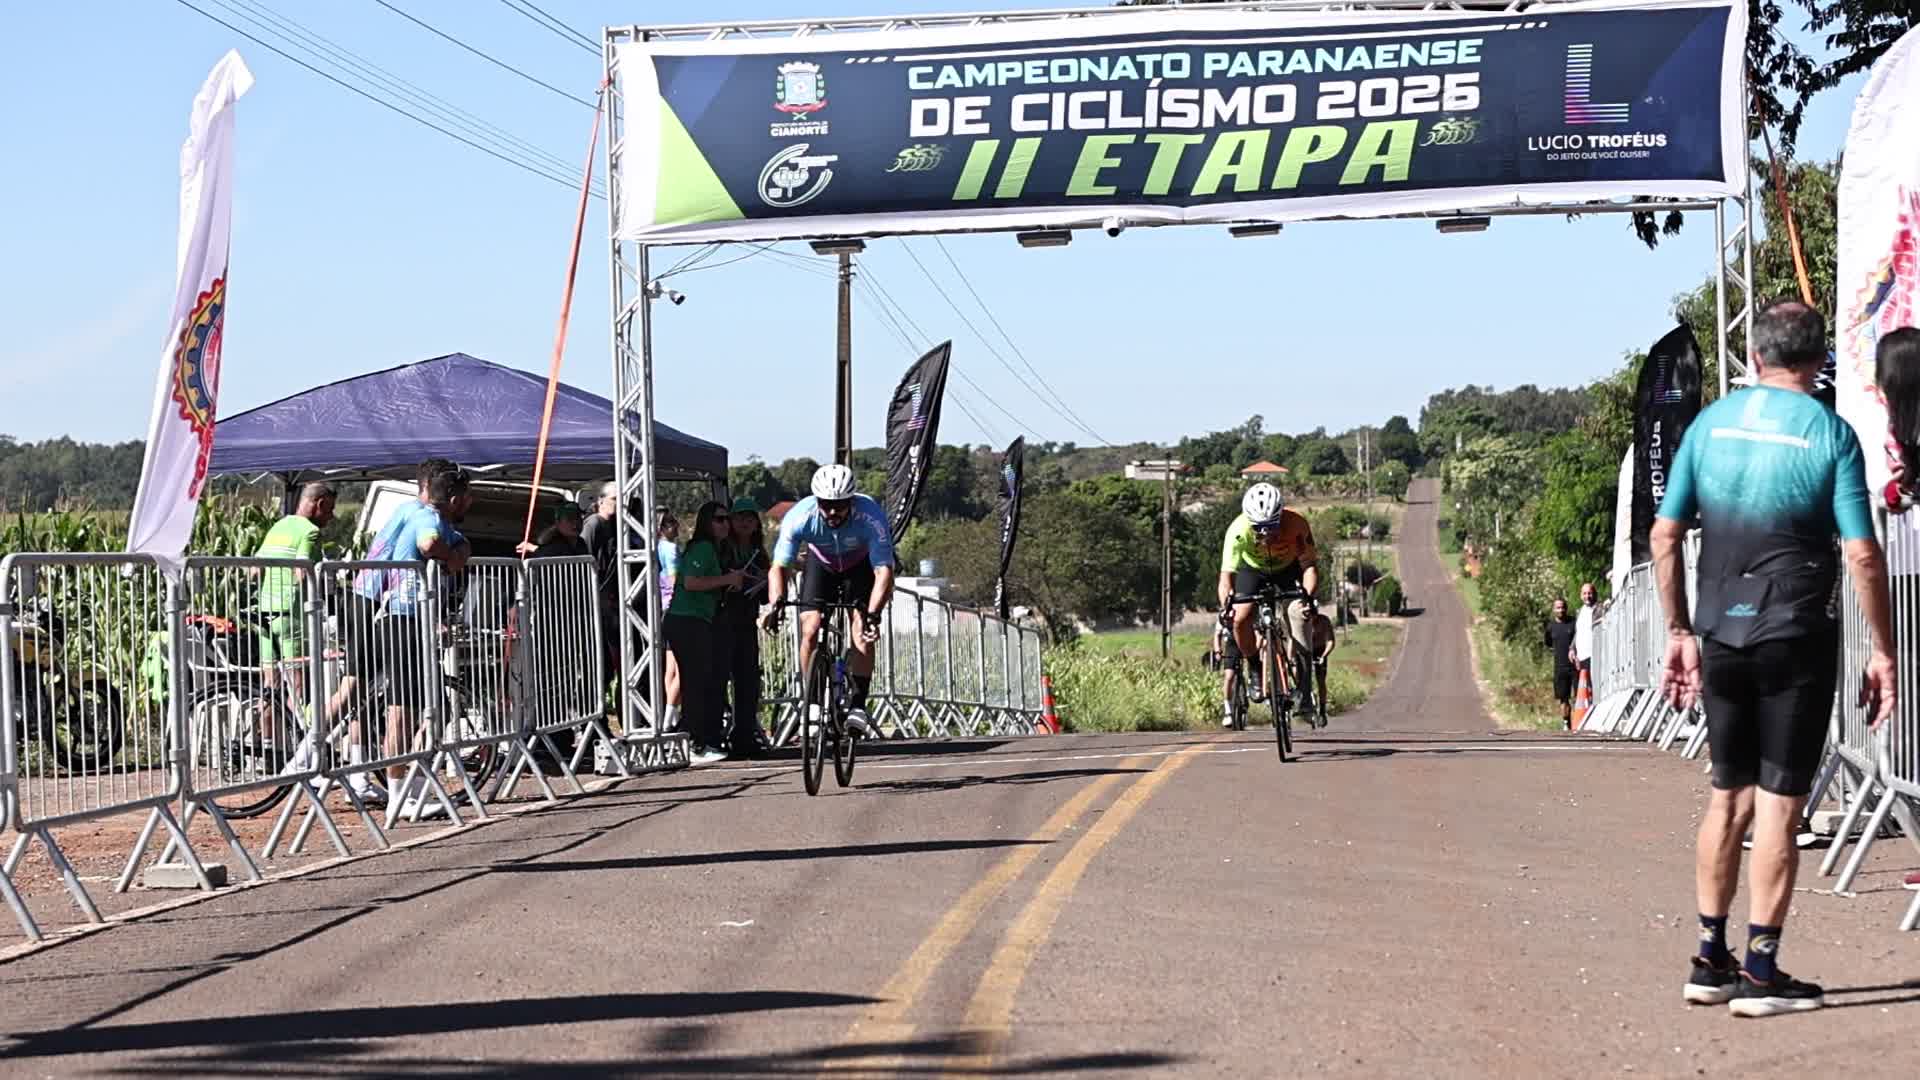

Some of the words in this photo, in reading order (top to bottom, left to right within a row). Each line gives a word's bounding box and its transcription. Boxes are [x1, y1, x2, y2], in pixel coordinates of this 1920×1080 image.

[908, 52, 1191, 90] CAMPEONATO
[1203, 38, 1484, 79] PARANAENSE
[909, 96, 991, 137] DE
[1010, 77, 1297, 132] CICLÍSMO
[770, 126, 829, 137] CIANORTE
[1528, 134, 1583, 151] LUCIO
[1587, 131, 1668, 148] TROFÉUS
[951, 136, 1043, 201] II
[1065, 119, 1419, 197] ETAPA
[1546, 153, 1560, 161] DO
[1560, 152, 1581, 161] JEITO
